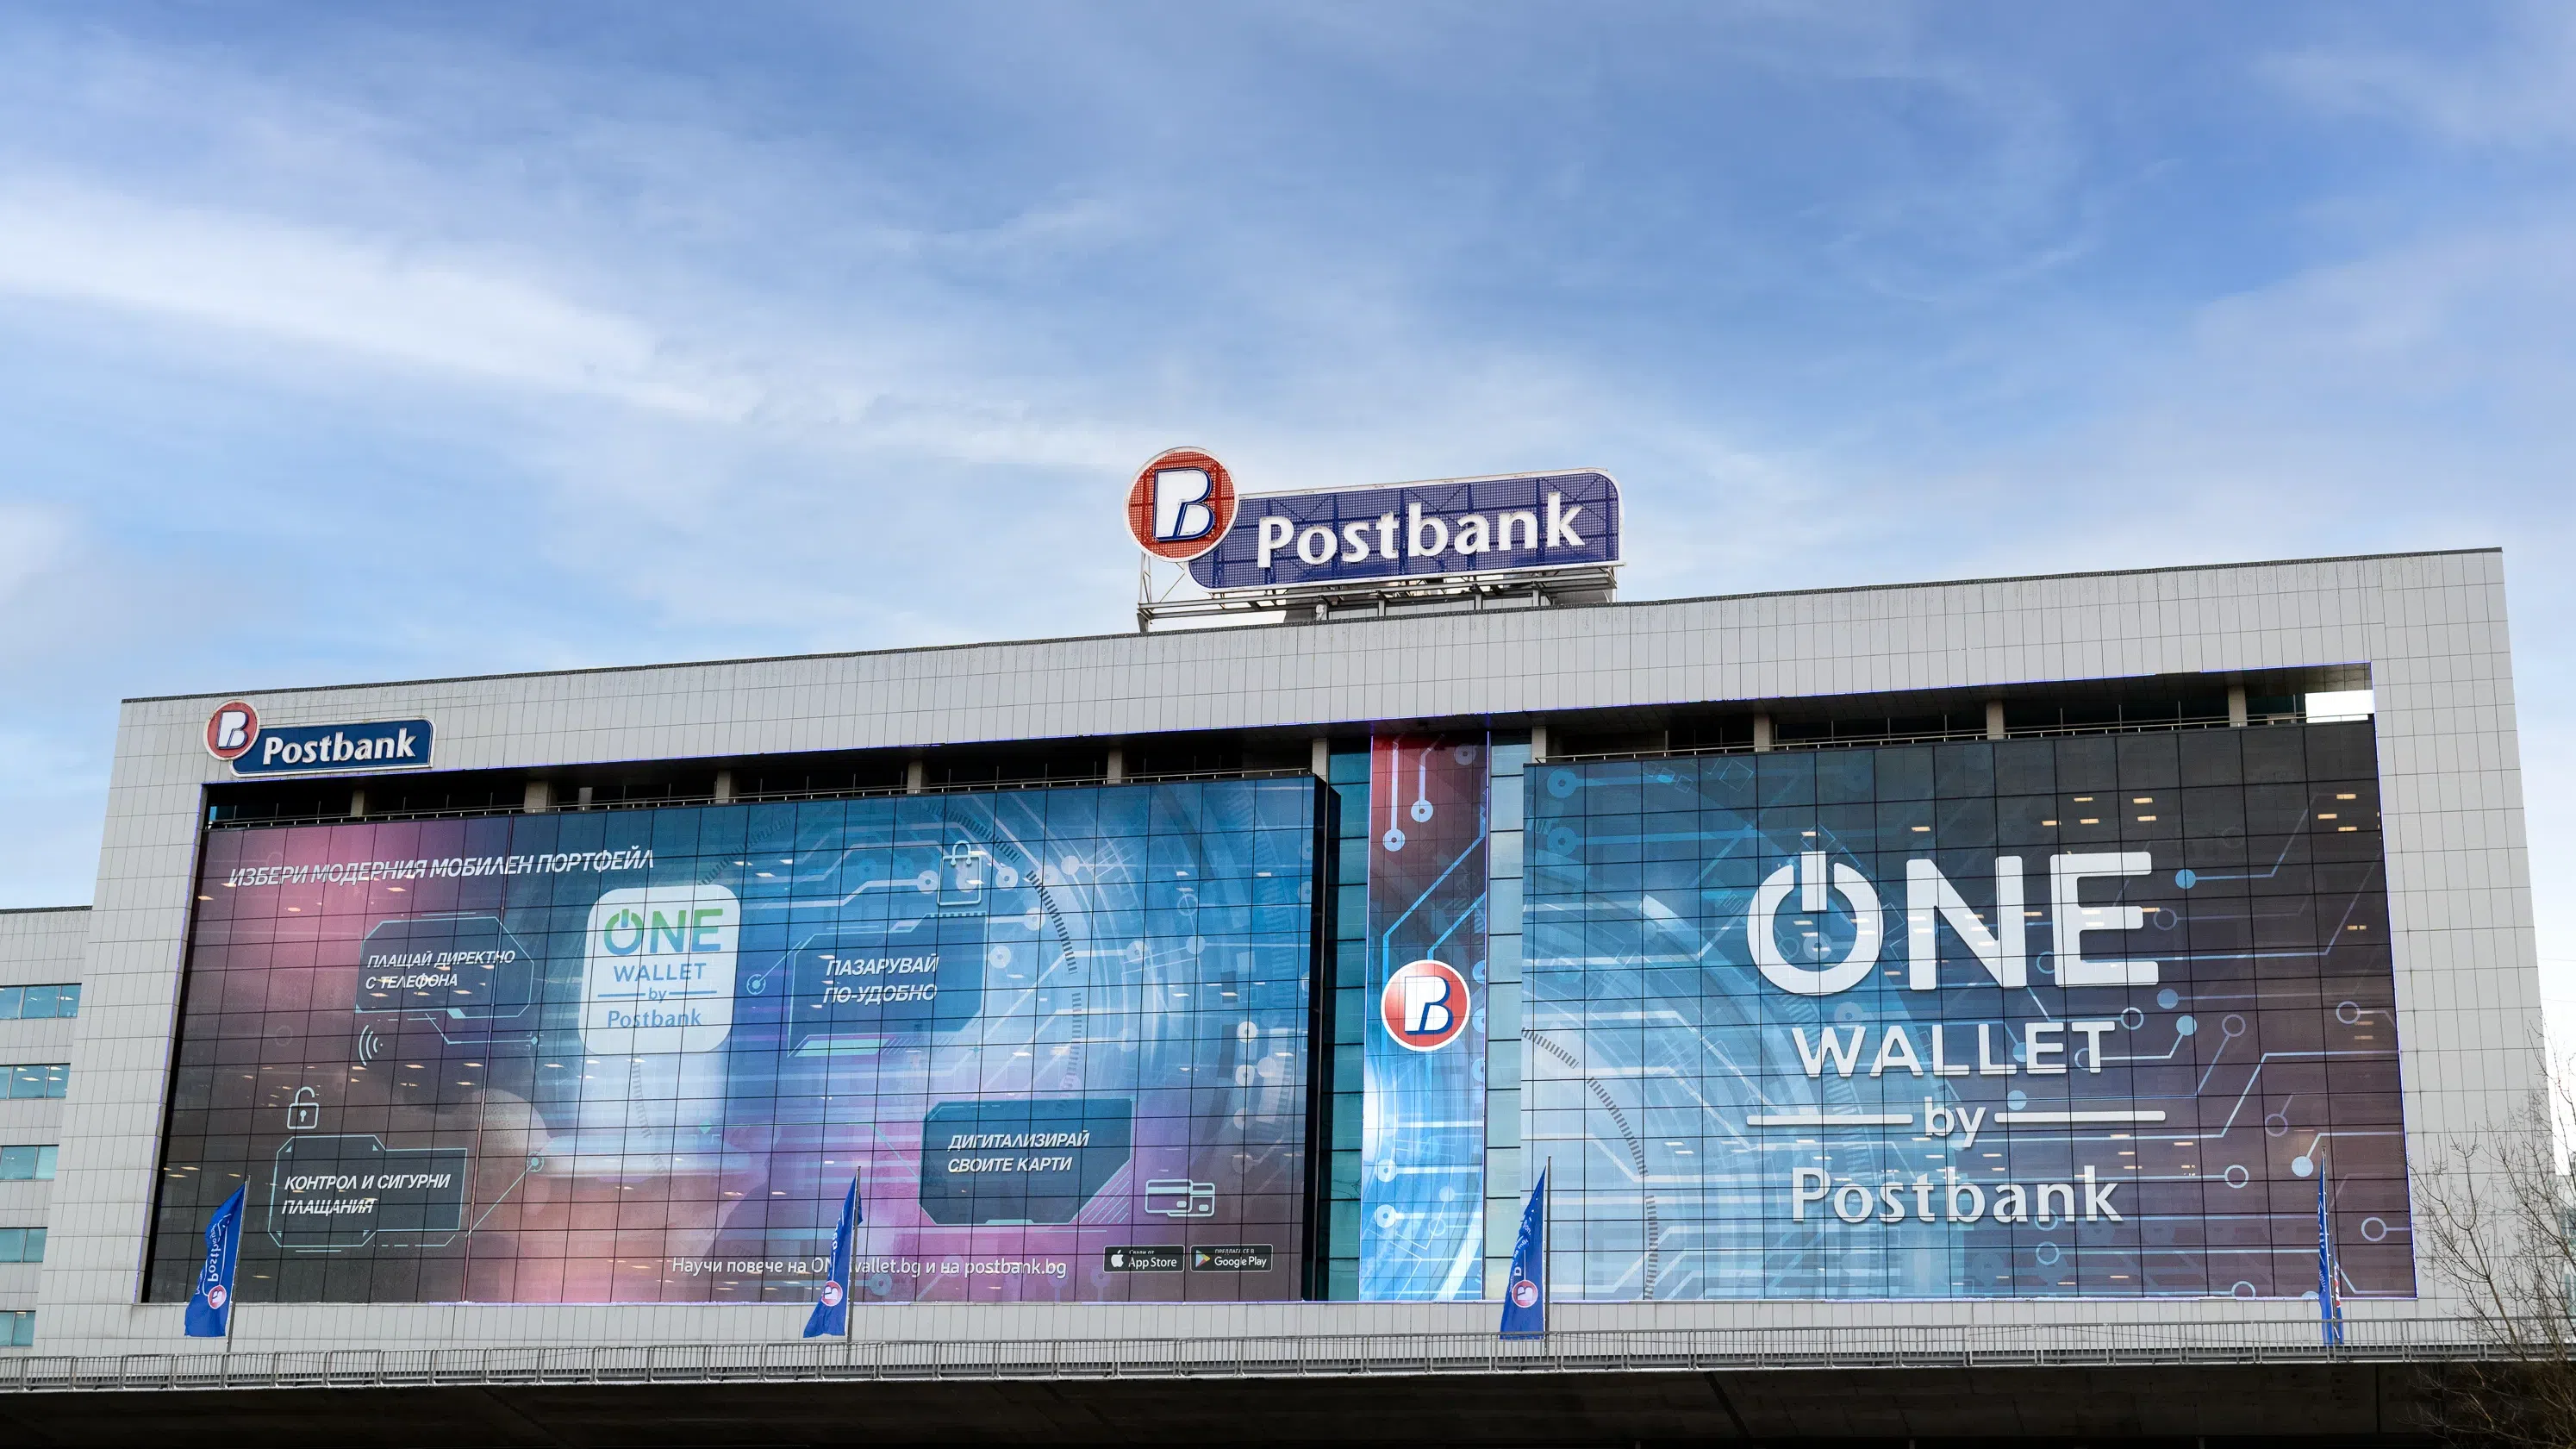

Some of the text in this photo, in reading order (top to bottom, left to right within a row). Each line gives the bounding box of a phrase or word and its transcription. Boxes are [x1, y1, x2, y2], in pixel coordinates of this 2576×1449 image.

[1257, 491, 1586, 568] Postbank
[262, 728, 415, 765] Postbank
[228, 846, 654, 887] ИЗБЕРИ МОДЕРНИЯ МОБИЛЕН ПОРТФЕЙЛ
[603, 909, 723, 956] ONE
[1747, 850, 2159, 996] ONE
[367, 950, 515, 969] ПЛАЩАЙ ДИРЕКТНО
[826, 953, 939, 976] ПАЗАРУВАЙ
[365, 973, 458, 990] С ТЕЛЕФОНА
[614, 963, 707, 982] WALLET
[649, 987, 667, 1003] by
[823, 984, 937, 1006] ПО-УДОБНО
[608, 1009, 702, 1028] Postbank
[1793, 1021, 2116, 1077] WALLET
[1924, 1096, 1986, 1148] by
[947, 1130, 1090, 1152] ДИГИТАЛИЗИРАЙ
[948, 1157, 1073, 1173] СВОИТЕ КАРТИ
[284, 1174, 451, 1190] КОНТРОЛ И СИГУРНИ
[1793, 1165, 2124, 1223] Postbank
[282, 1199, 375, 1216] ПЛАЩАНИЯ
[672, 1257, 722, 1277] Научи
[727, 1260, 783, 1273] повече
[787, 1260, 807, 1273] на
[926, 1262, 936, 1273] и
[940, 1261, 960, 1273] на
[964, 1258, 1067, 1278] postbank.bg
[1128, 1257, 1177, 1270] App Store
[1214, 1256, 1267, 1268] Google Play
